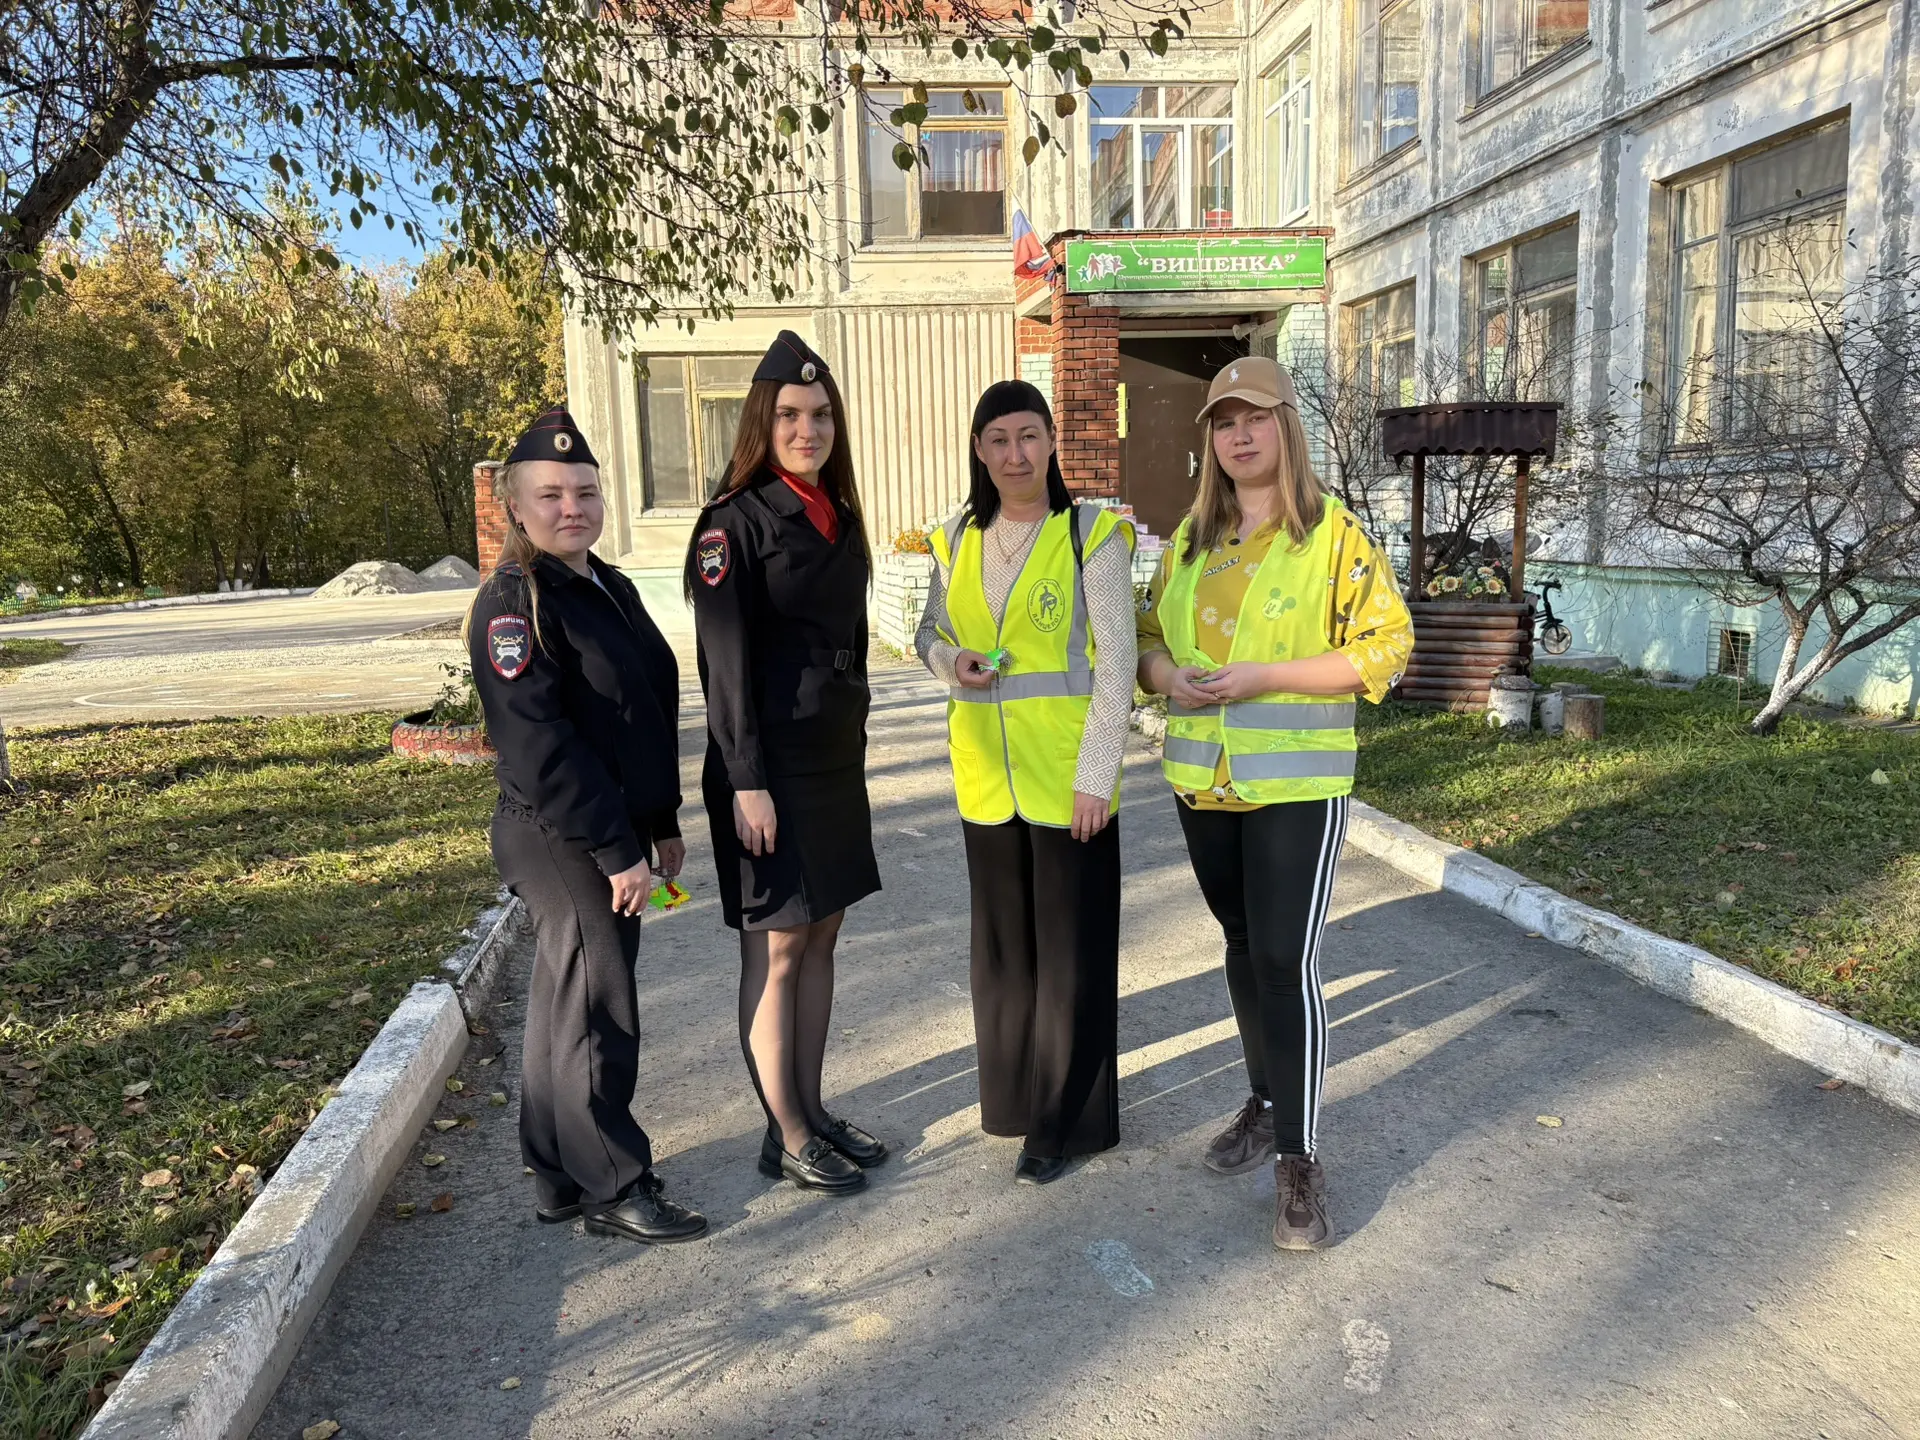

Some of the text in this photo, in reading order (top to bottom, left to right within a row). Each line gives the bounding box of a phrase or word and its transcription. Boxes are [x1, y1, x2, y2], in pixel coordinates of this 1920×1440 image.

[1203, 555, 1241, 578] MICKEY
[491, 617, 526, 627] ПОЛИЦИЯ
[501, 667, 517, 678] МВД
